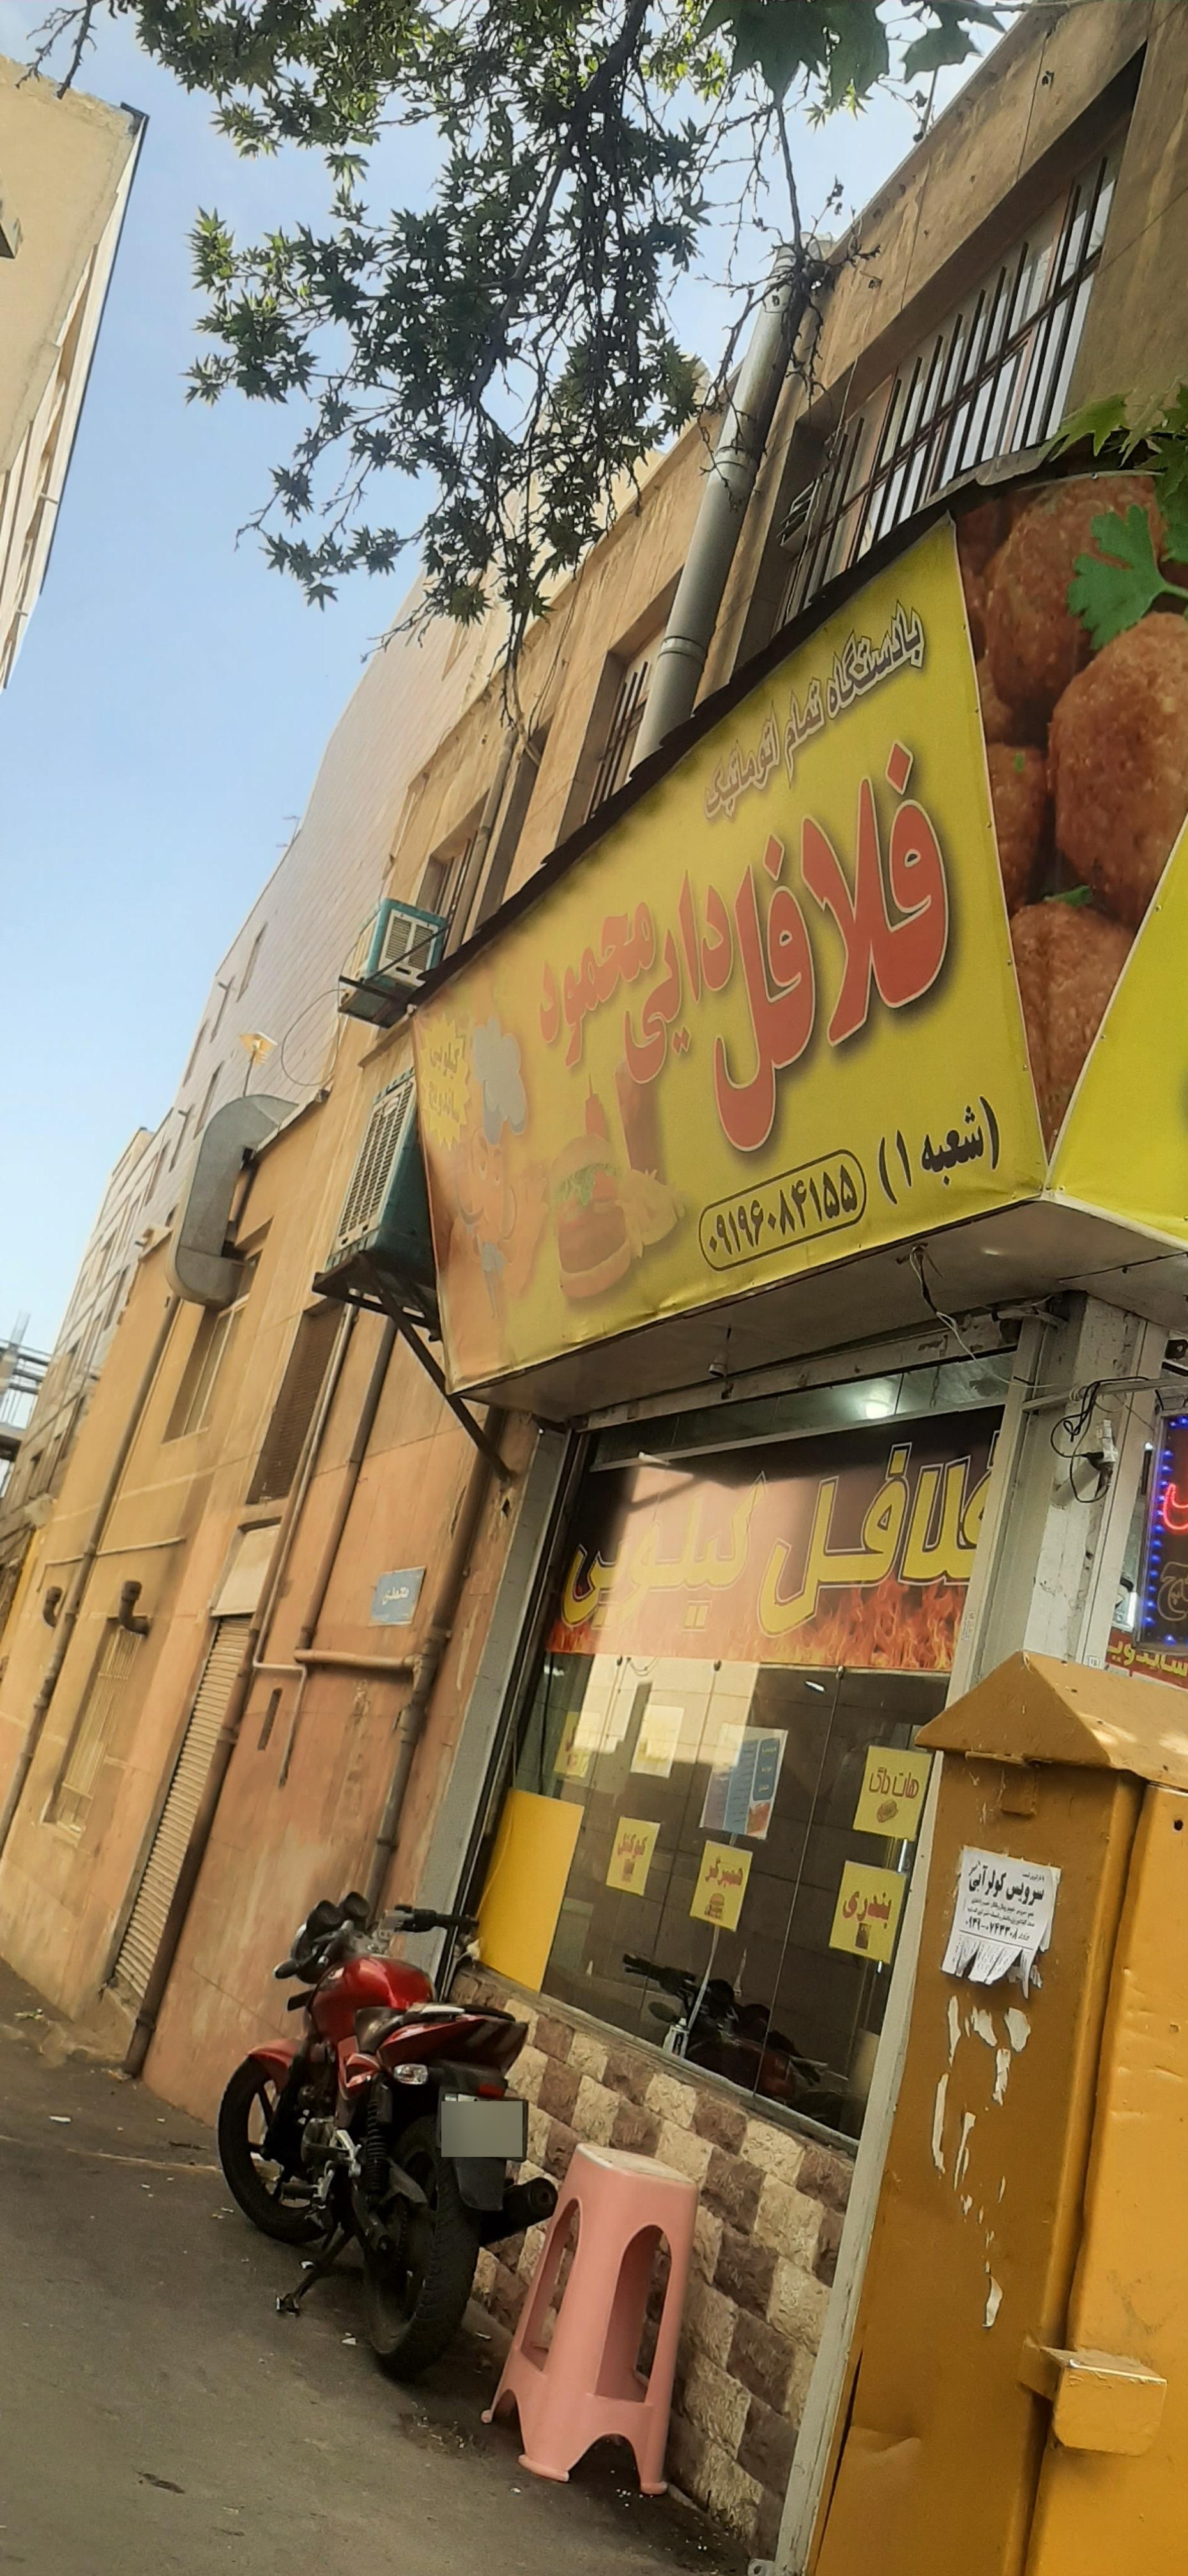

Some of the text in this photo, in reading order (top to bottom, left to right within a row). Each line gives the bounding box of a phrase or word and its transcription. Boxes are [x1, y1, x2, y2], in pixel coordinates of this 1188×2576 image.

[784, 678, 826, 790] تمام
[705, 700, 779, 819] اتوماتیک
[539, 740, 950, 1153] فلافل دایی محمود
[709, 1164, 858, 1255] ۰۹۱۹۶۰۸۴۱۵۵
[892, 1772, 919, 1799] هات
[968, 1864, 988, 1892] آبی
[984, 1869, 1007, 1897] کولر
[1005, 1881, 1045, 1906] سرویس
[842, 1891, 892, 1929] بندری
